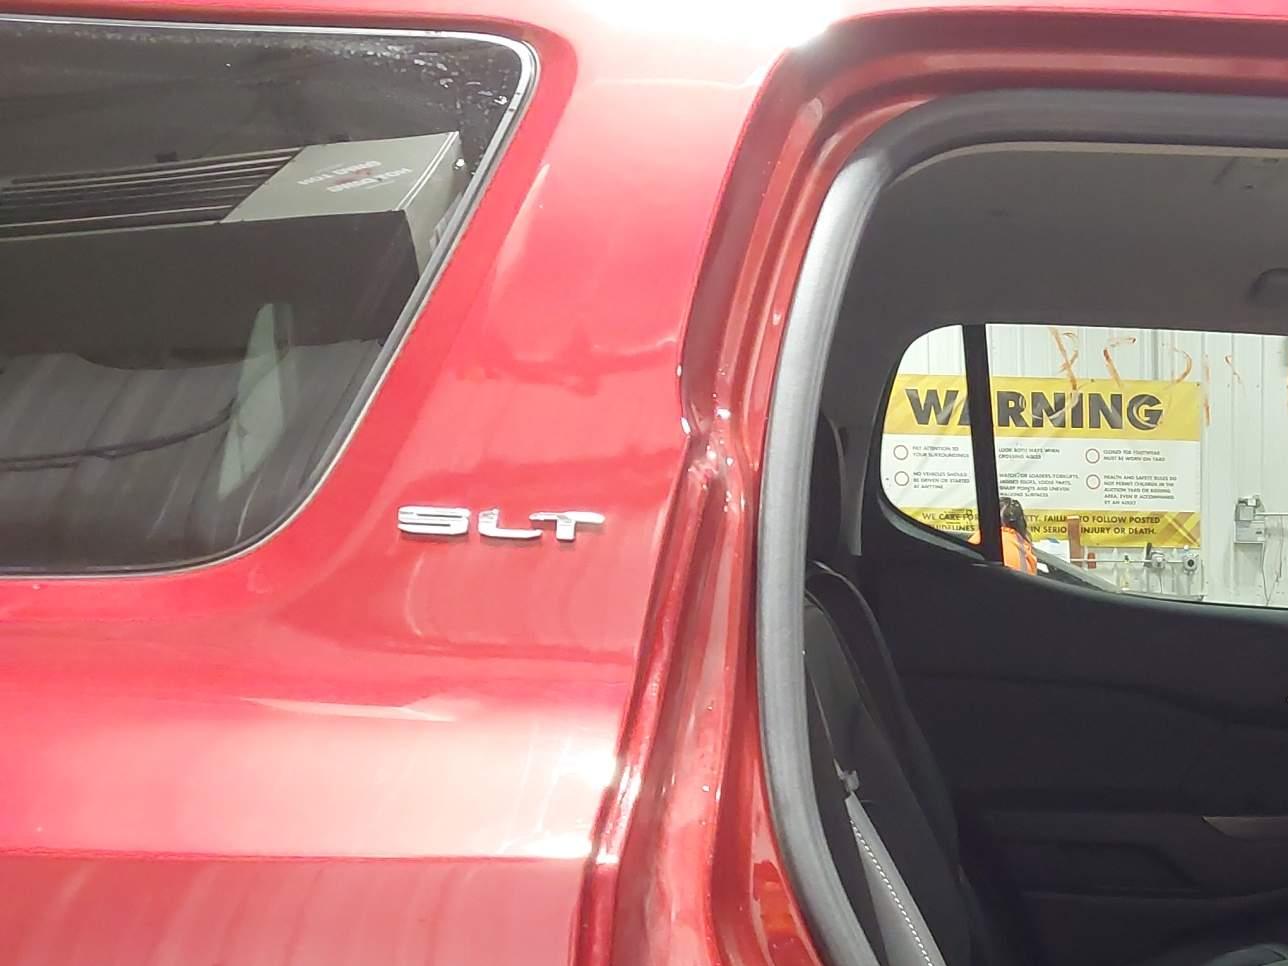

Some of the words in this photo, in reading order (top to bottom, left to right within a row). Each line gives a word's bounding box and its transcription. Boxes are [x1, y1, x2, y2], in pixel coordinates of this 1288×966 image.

[397, 504, 606, 541] SLT
[1092, 516, 1127, 524] FOLLOW
[1129, 516, 1160, 524] POSTED
[1080, 526, 1110, 534] INJURY
